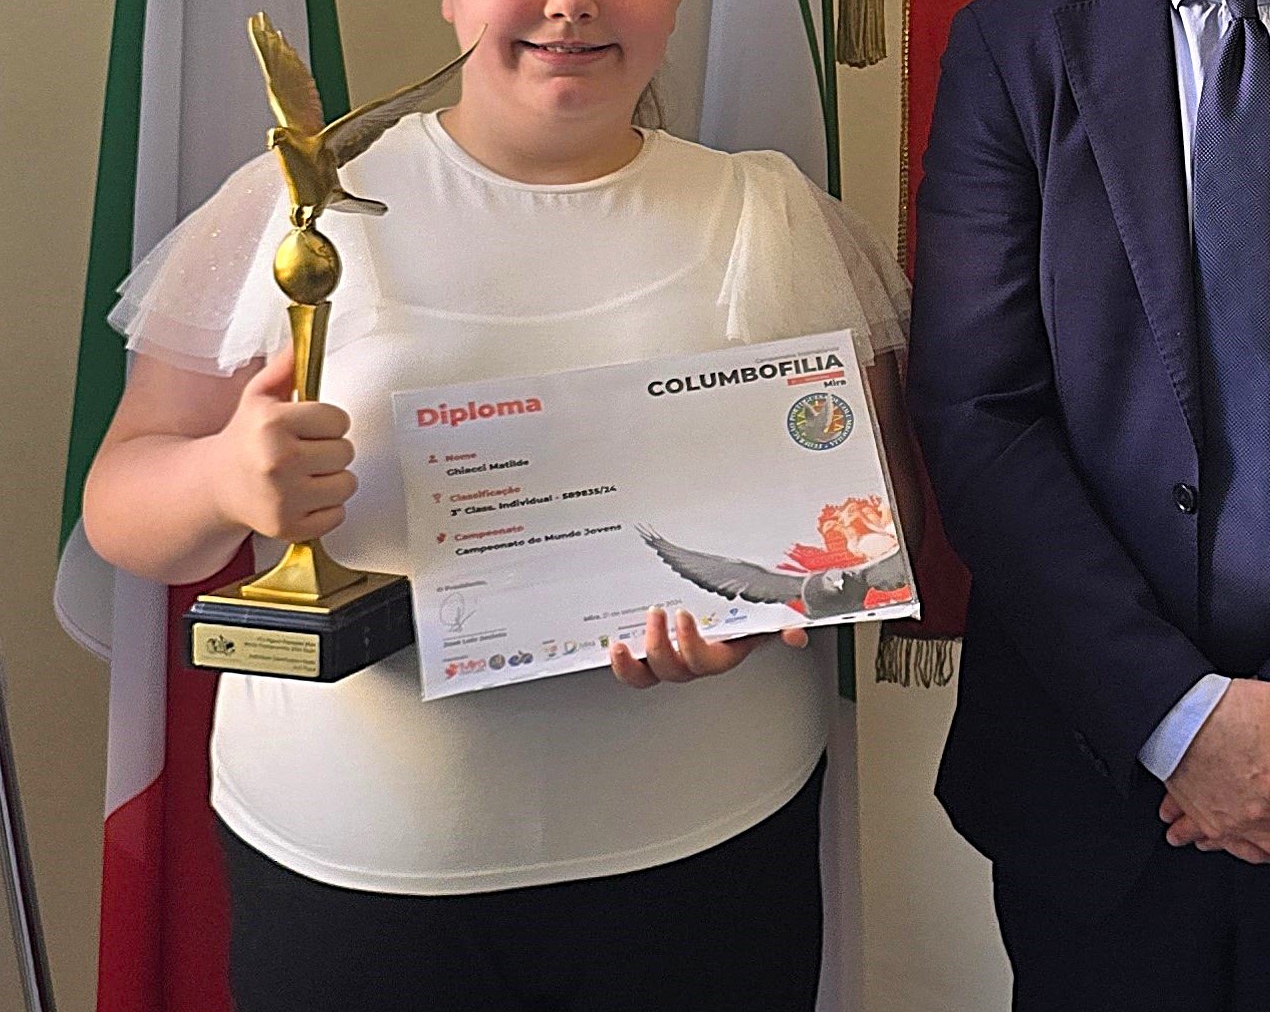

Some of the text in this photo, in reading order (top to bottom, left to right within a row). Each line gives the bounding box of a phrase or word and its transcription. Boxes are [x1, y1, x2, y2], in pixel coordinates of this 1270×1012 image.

[647, 354, 844, 397] COLUMBOFILIA
[823, 378, 847, 388] Mira
[416, 395, 543, 428] Diploma
[445, 452, 478, 462] Nome
[446, 458, 530, 477] Ghiacci Matilde
[450, 486, 522, 503] Classificação
[464, 502, 496, 515] Class.
[498, 494, 553, 510] Individual
[454, 524, 525, 543] Campeonato
[455, 539, 526, 557] Campeonato
[544, 529, 582, 542] Mundo
[583, 522, 622, 536] Jovens
